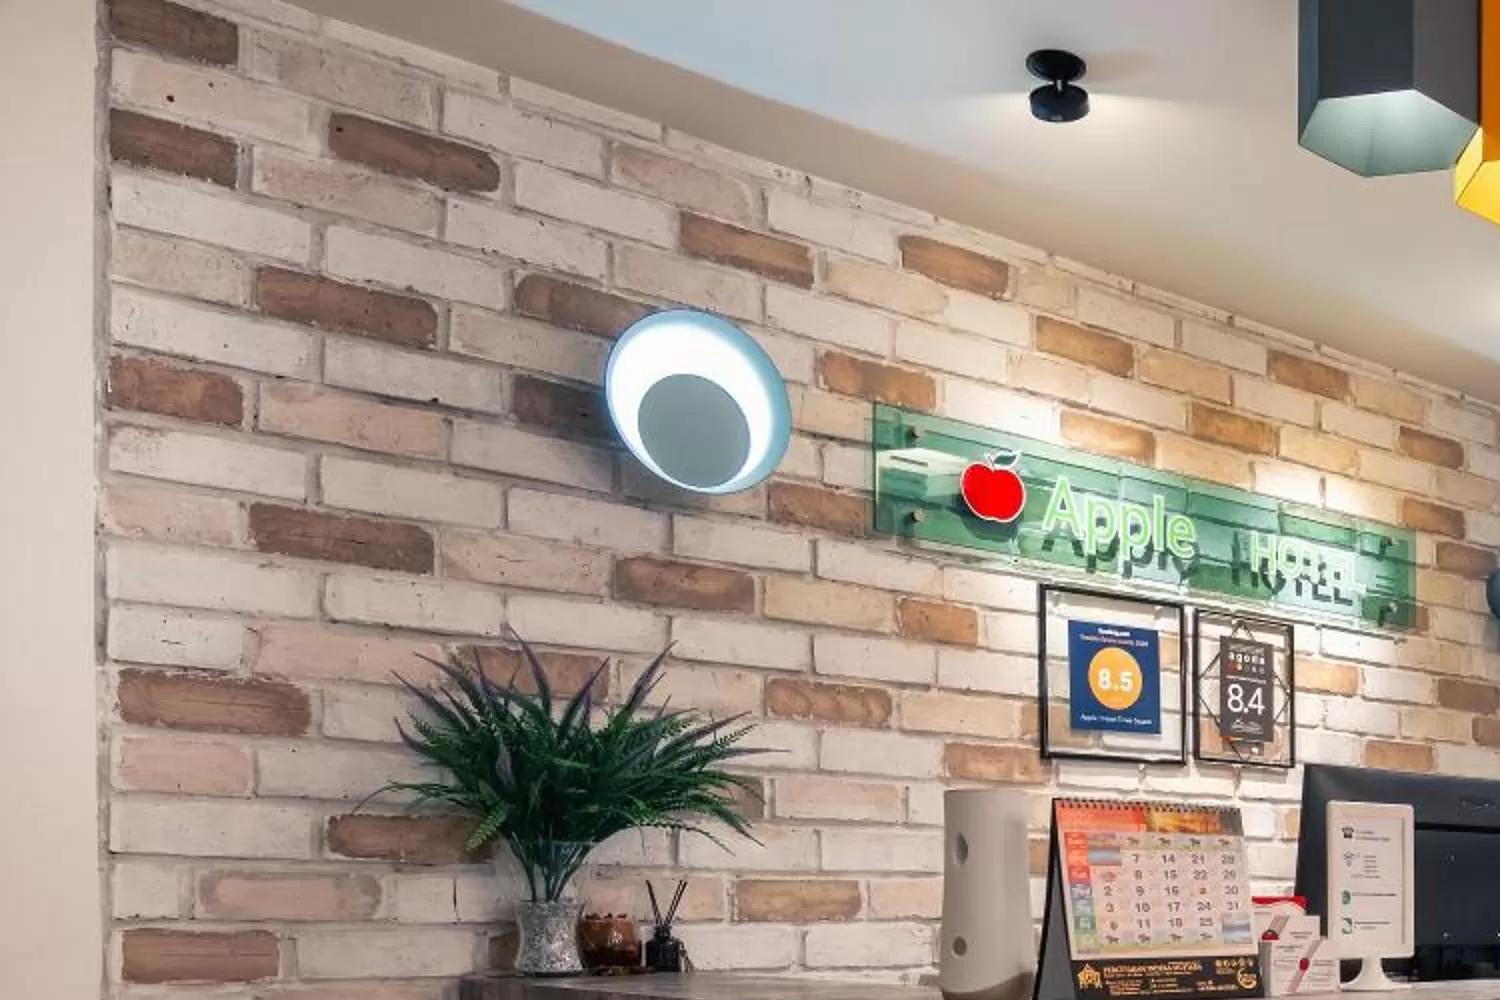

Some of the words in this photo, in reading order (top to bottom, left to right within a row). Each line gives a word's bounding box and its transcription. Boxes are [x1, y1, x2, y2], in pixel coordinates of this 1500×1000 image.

[1042, 475, 1195, 561] Apple
[1250, 530, 1367, 594] HOTEL
[1098, 668, 1134, 692] 8.5
[1227, 683, 1265, 715] 8.4
